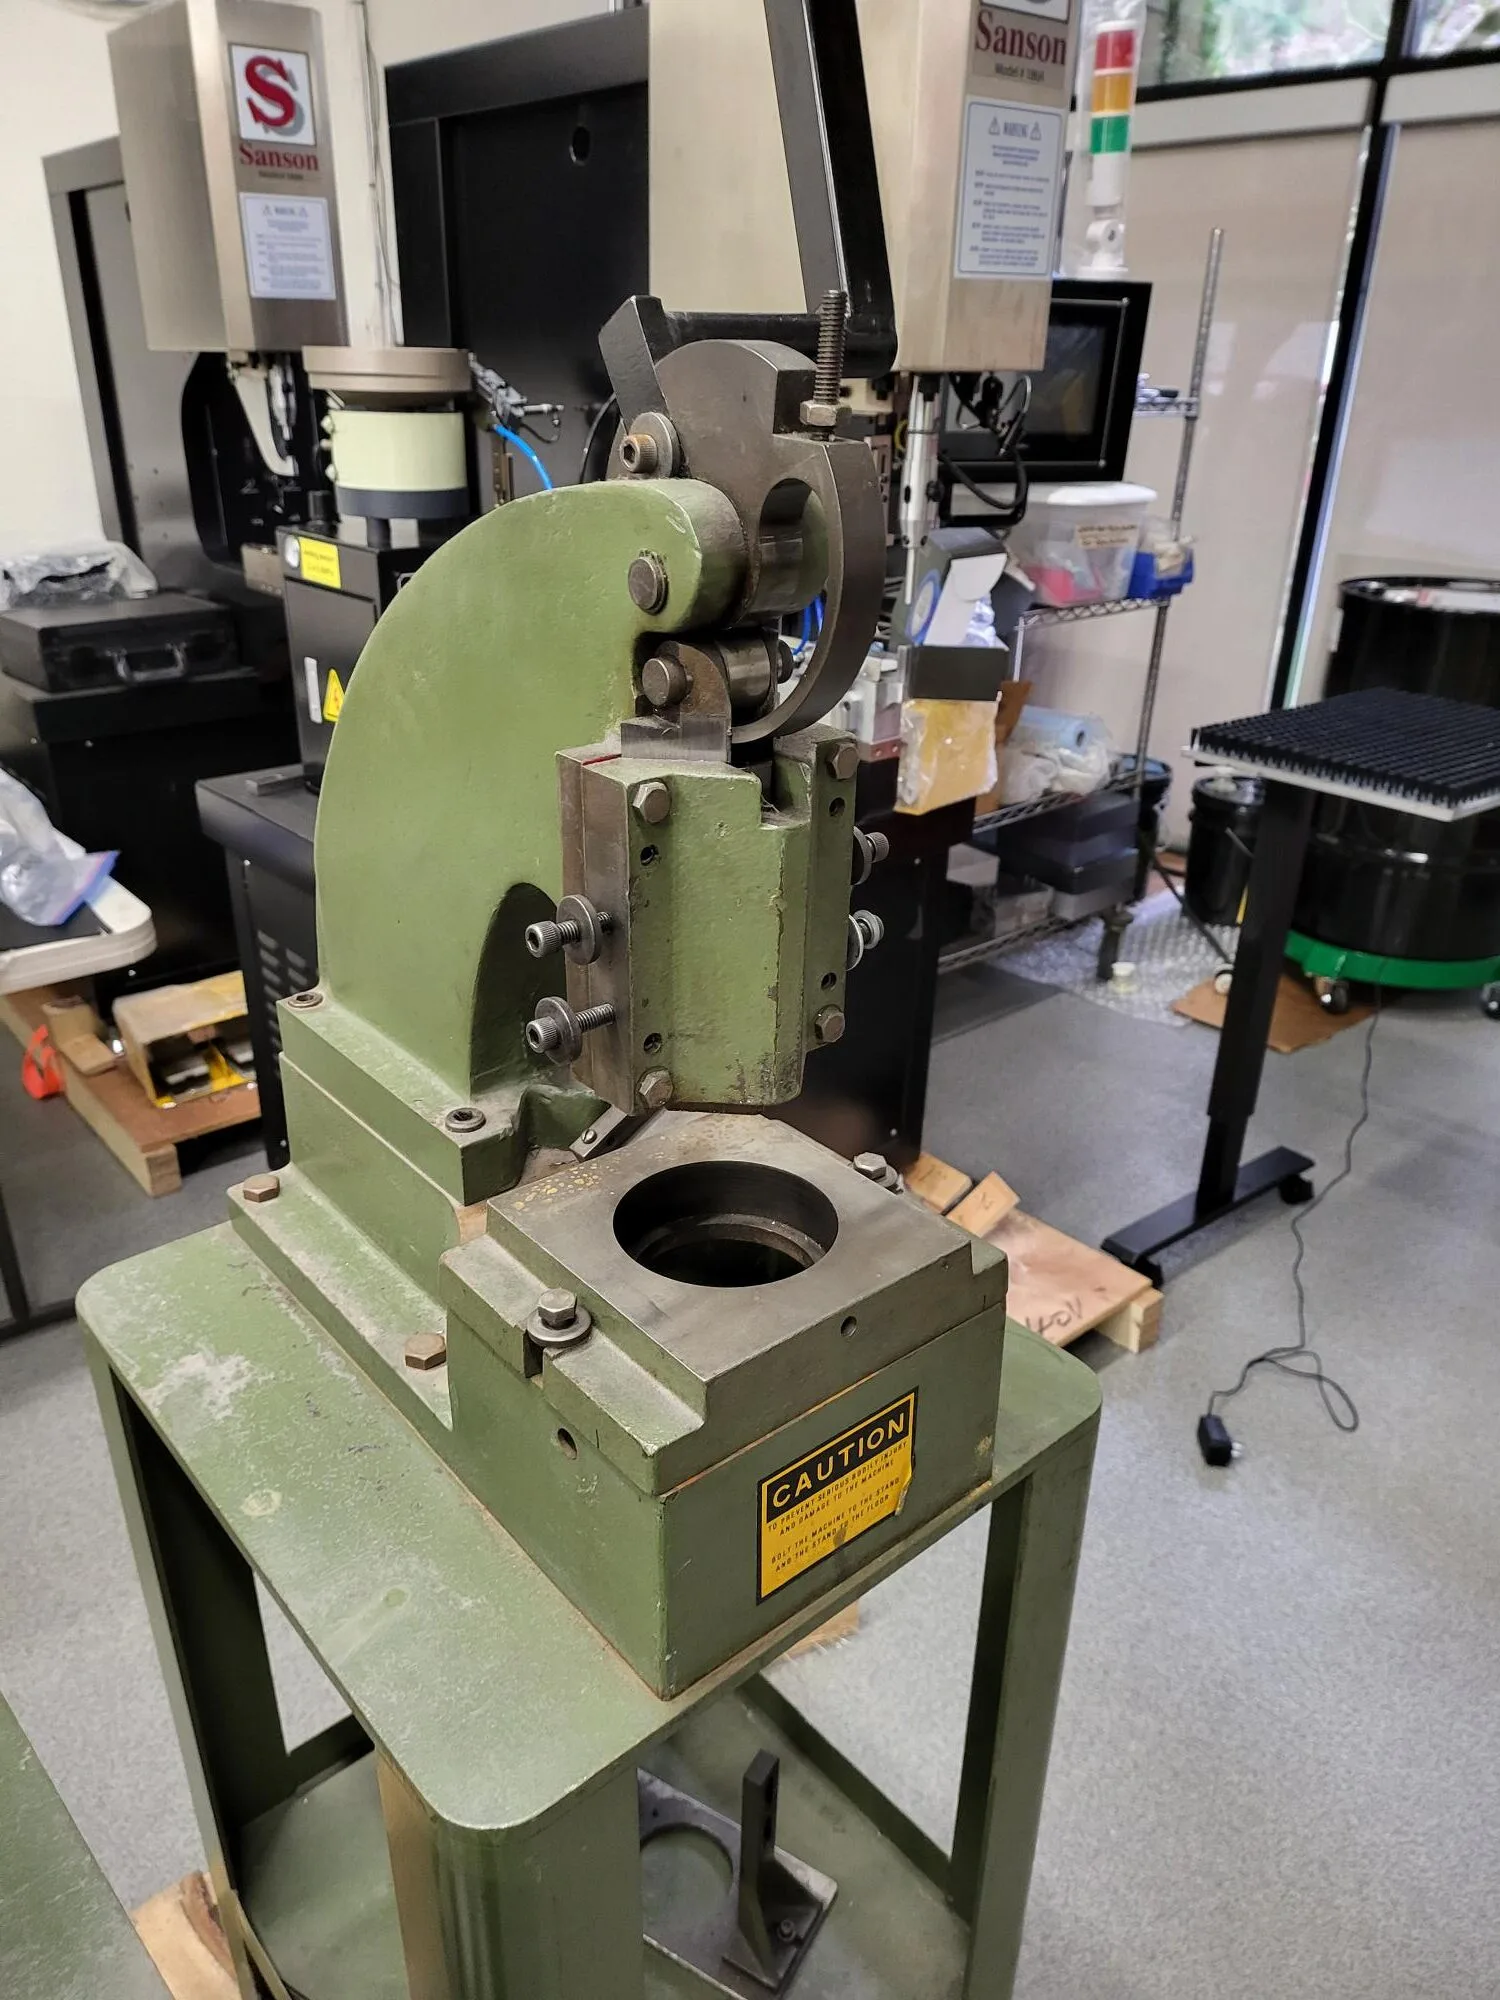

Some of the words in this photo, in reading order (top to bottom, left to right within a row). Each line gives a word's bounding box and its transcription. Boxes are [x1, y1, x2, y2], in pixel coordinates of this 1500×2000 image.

[975, 8, 1068, 66] Sanson
[245, 55, 296, 127] S
[239, 142, 319, 172] Sanson
[768, 1522, 778, 1532] TO
[781, 1499, 814, 1525] PREVENT
[817, 1477, 849, 1501] SERIOUS
[852, 1459, 879, 1480] BODILY
[881, 1441, 907, 1462] INJURY
[773, 1413, 904, 1508] CAUTION
[779, 1521, 796, 1536] AND
[799, 1500, 830, 1525] DAMAGE
[833, 1492, 842, 1502] TO
[845, 1482, 858, 1494] THE
[861, 1458, 894, 1484] MACHINE
[771, 1546, 791, 1564] BOLT
[795, 1535, 808, 1549] THE
[811, 1510, 845, 1537] MACHINE
[848, 1503, 857, 1513] TO
[860, 1492, 872, 1506] THE
[876, 1477, 900, 1497] STAND
[775, 1558, 792, 1572] AND
[795, 1546, 809, 1559] THE
[812, 1528, 837, 1549] STAND
[840, 1521, 849, 1531] TO
[851, 1509, 864, 1523] THE
[866, 1493, 890, 1513] FLOOR
